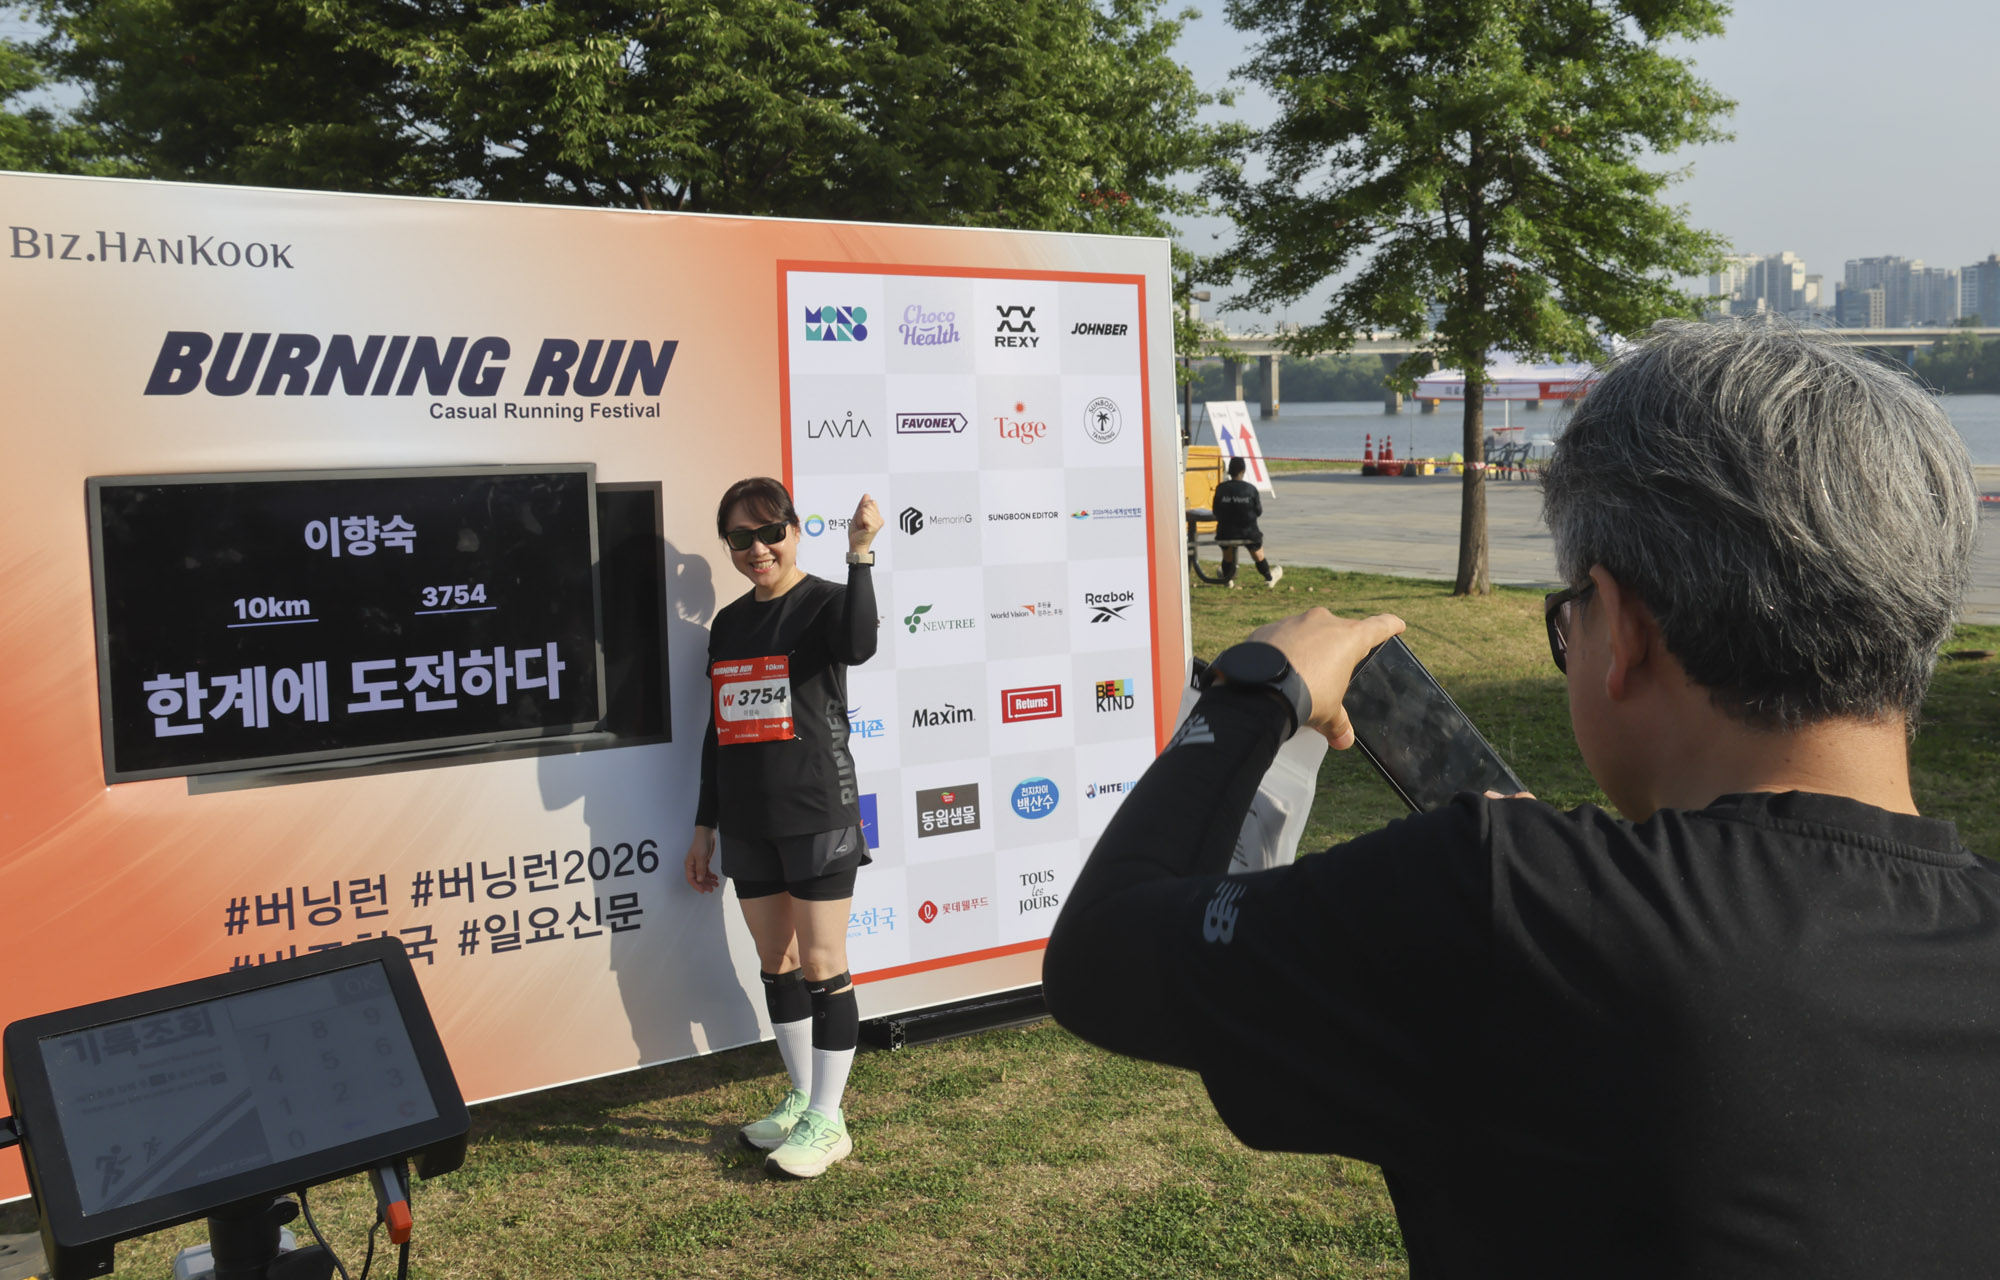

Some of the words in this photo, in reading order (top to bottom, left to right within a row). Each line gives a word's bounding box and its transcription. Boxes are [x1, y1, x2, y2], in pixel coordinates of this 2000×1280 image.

[903, 304, 956, 325] Choco
[898, 323, 961, 346] Health
[1071, 323, 1128, 336] JOHNBER
[994, 336, 1040, 348] REXY
[143, 331, 511, 397] BURNING
[524, 338, 679, 397] RUN
[429, 402, 498, 420] Casual
[503, 403, 584, 423] Running
[589, 401, 661, 420] Festival
[1088, 400, 1116, 414] SUNBODY
[901, 418, 956, 430] FAVONEX
[993, 416, 1047, 445] Tage
[1091, 430, 1115, 441] TANNING
[929, 513, 972, 526] MemorinG
[988, 513, 1030, 522] SUNGBOON
[1032, 511, 1059, 521] EDITOR
[304, 515, 417, 557] 이향숙
[233, 597, 310, 620] 10km
[421, 583, 487, 608] 3754
[1085, 590, 1135, 606] Reebok
[923, 618, 976, 632] NEWTREE
[990, 611, 1009, 620] World
[1010, 610, 1029, 619] Vision
[739, 664, 753, 673] RUN
[765, 663, 784, 671] 10km
[142, 661, 329, 737] 한계에
[347, 641, 566, 715] 도전하다
[723, 694, 735, 707] W
[738, 686, 787, 707] 3754
[1096, 684, 1120, 699] BE-
[1015, 696, 1048, 711] Returns
[1096, 695, 1135, 713] KIND
[912, 704, 975, 728] Maxim
[1017, 794, 1054, 813] 백산수
[921, 805, 976, 831] 동원샘물
[224, 874, 390, 936] #버닝런
[410, 839, 660, 908] #버닝런2026
[1019, 869, 1055, 887] TOUS
[1031, 884, 1045, 898] les
[1018, 894, 1059, 915] JOURS
[457, 892, 643, 956] #일요신문
[344, 977, 379, 995] OK
[60, 1005, 216, 1067] 기록조회
[256, 1032, 272, 1053] 7
[310, 1019, 327, 1040] 8
[363, 1006, 380, 1027] 9
[266, 1065, 281, 1085] 4
[321, 1050, 338, 1071] 5
[374, 1036, 391, 1057] 6
[279, 1096, 291, 1117] 1
[332, 1082, 349, 1103] 2
[387, 1067, 402, 1088] 3
[287, 1128, 304, 1151] 0
